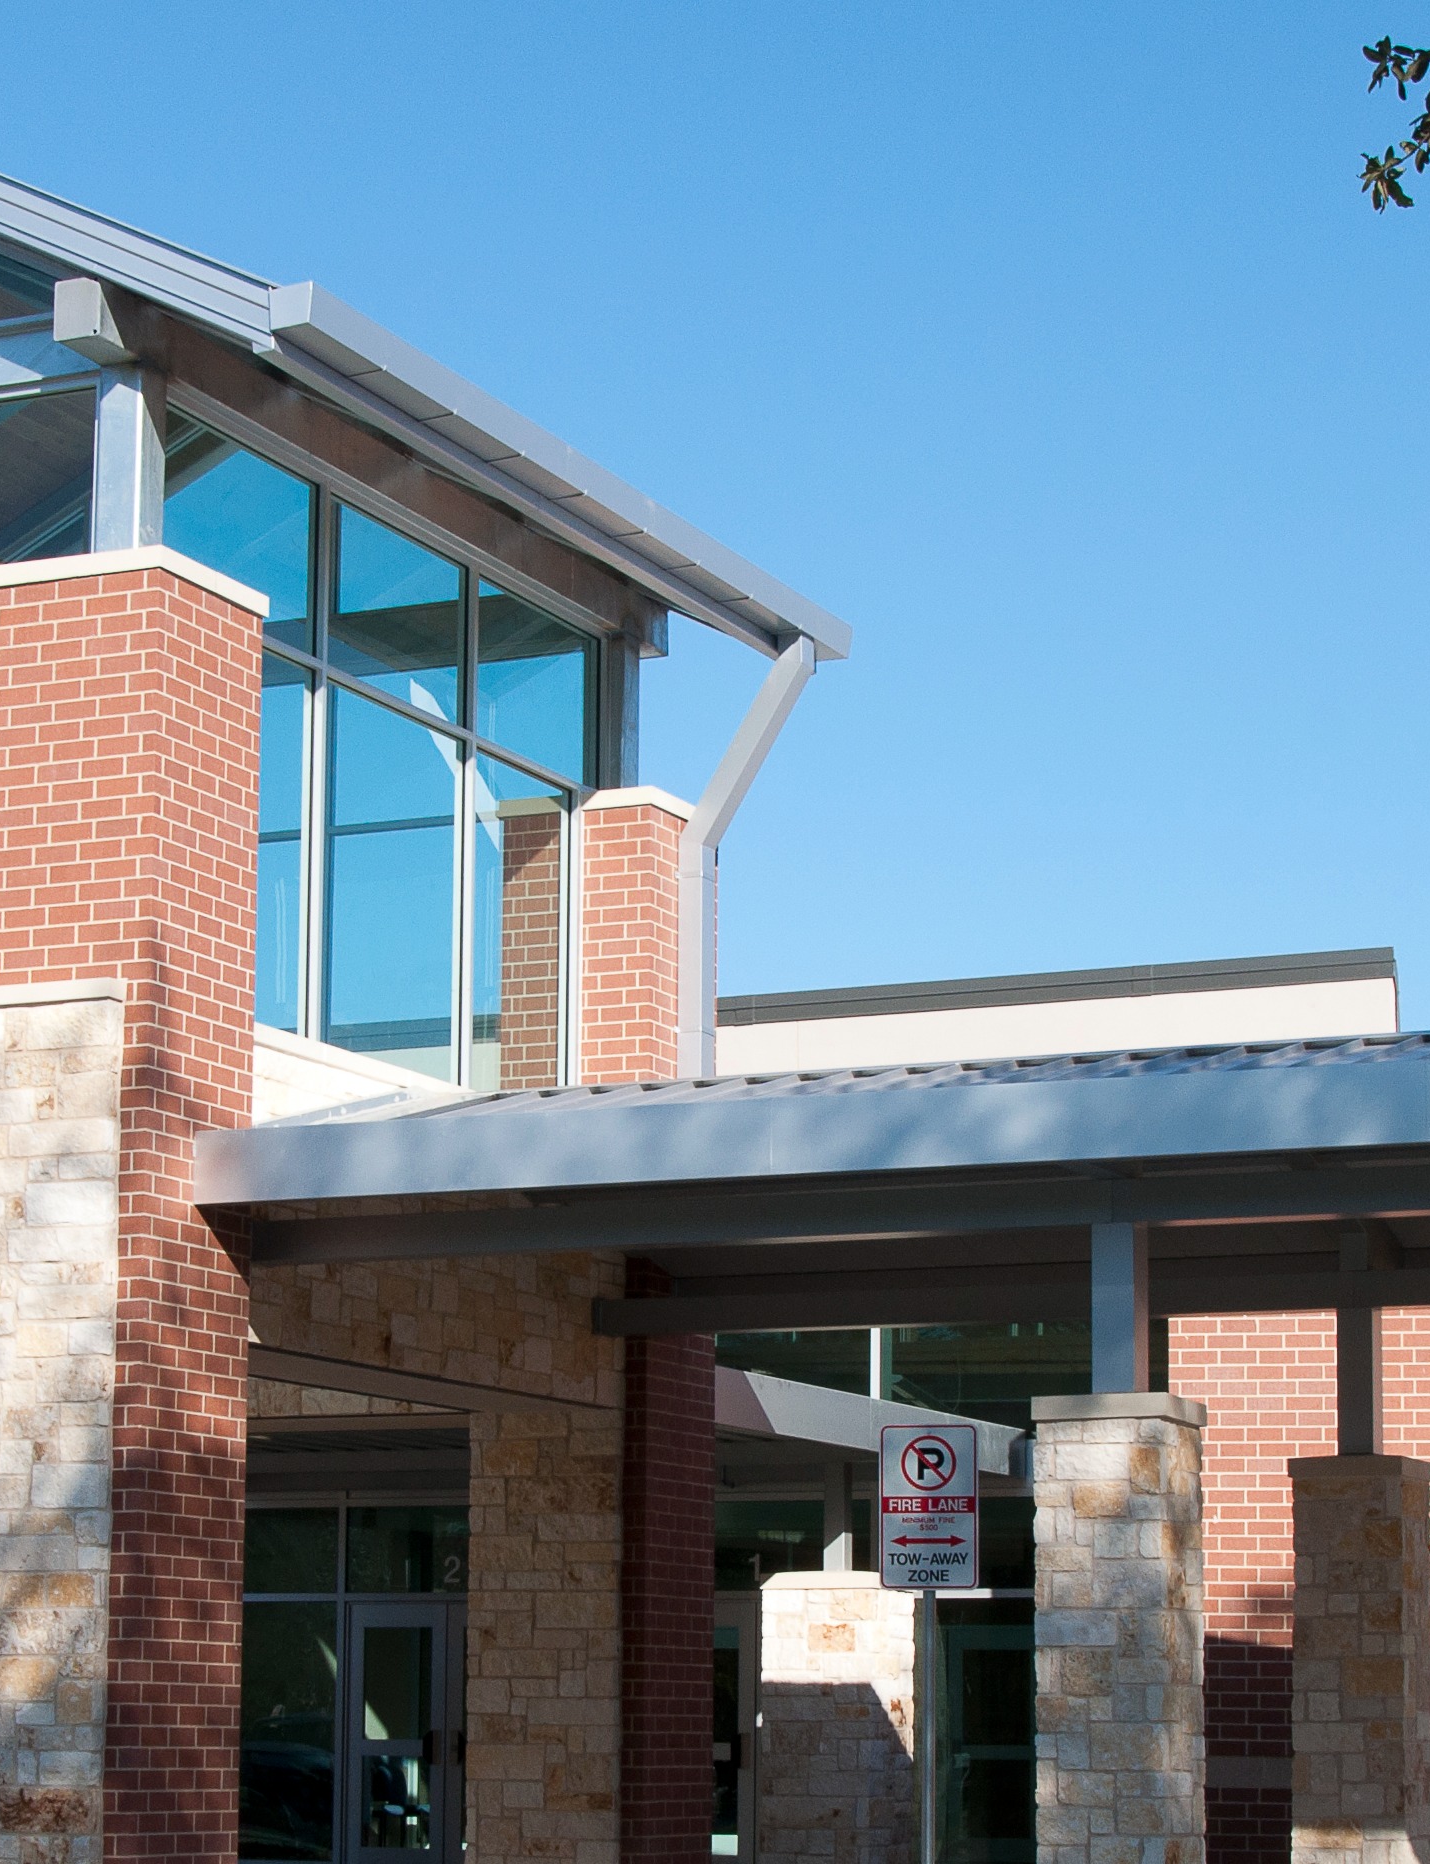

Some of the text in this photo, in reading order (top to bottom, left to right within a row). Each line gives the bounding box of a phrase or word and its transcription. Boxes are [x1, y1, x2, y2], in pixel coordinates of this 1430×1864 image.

[889, 1499, 968, 1511] FIRE LANE
[888, 1553, 968, 1565] TOW-AWAY
[444, 1556, 461, 1583] 2
[908, 1570, 949, 1582] ZONE
